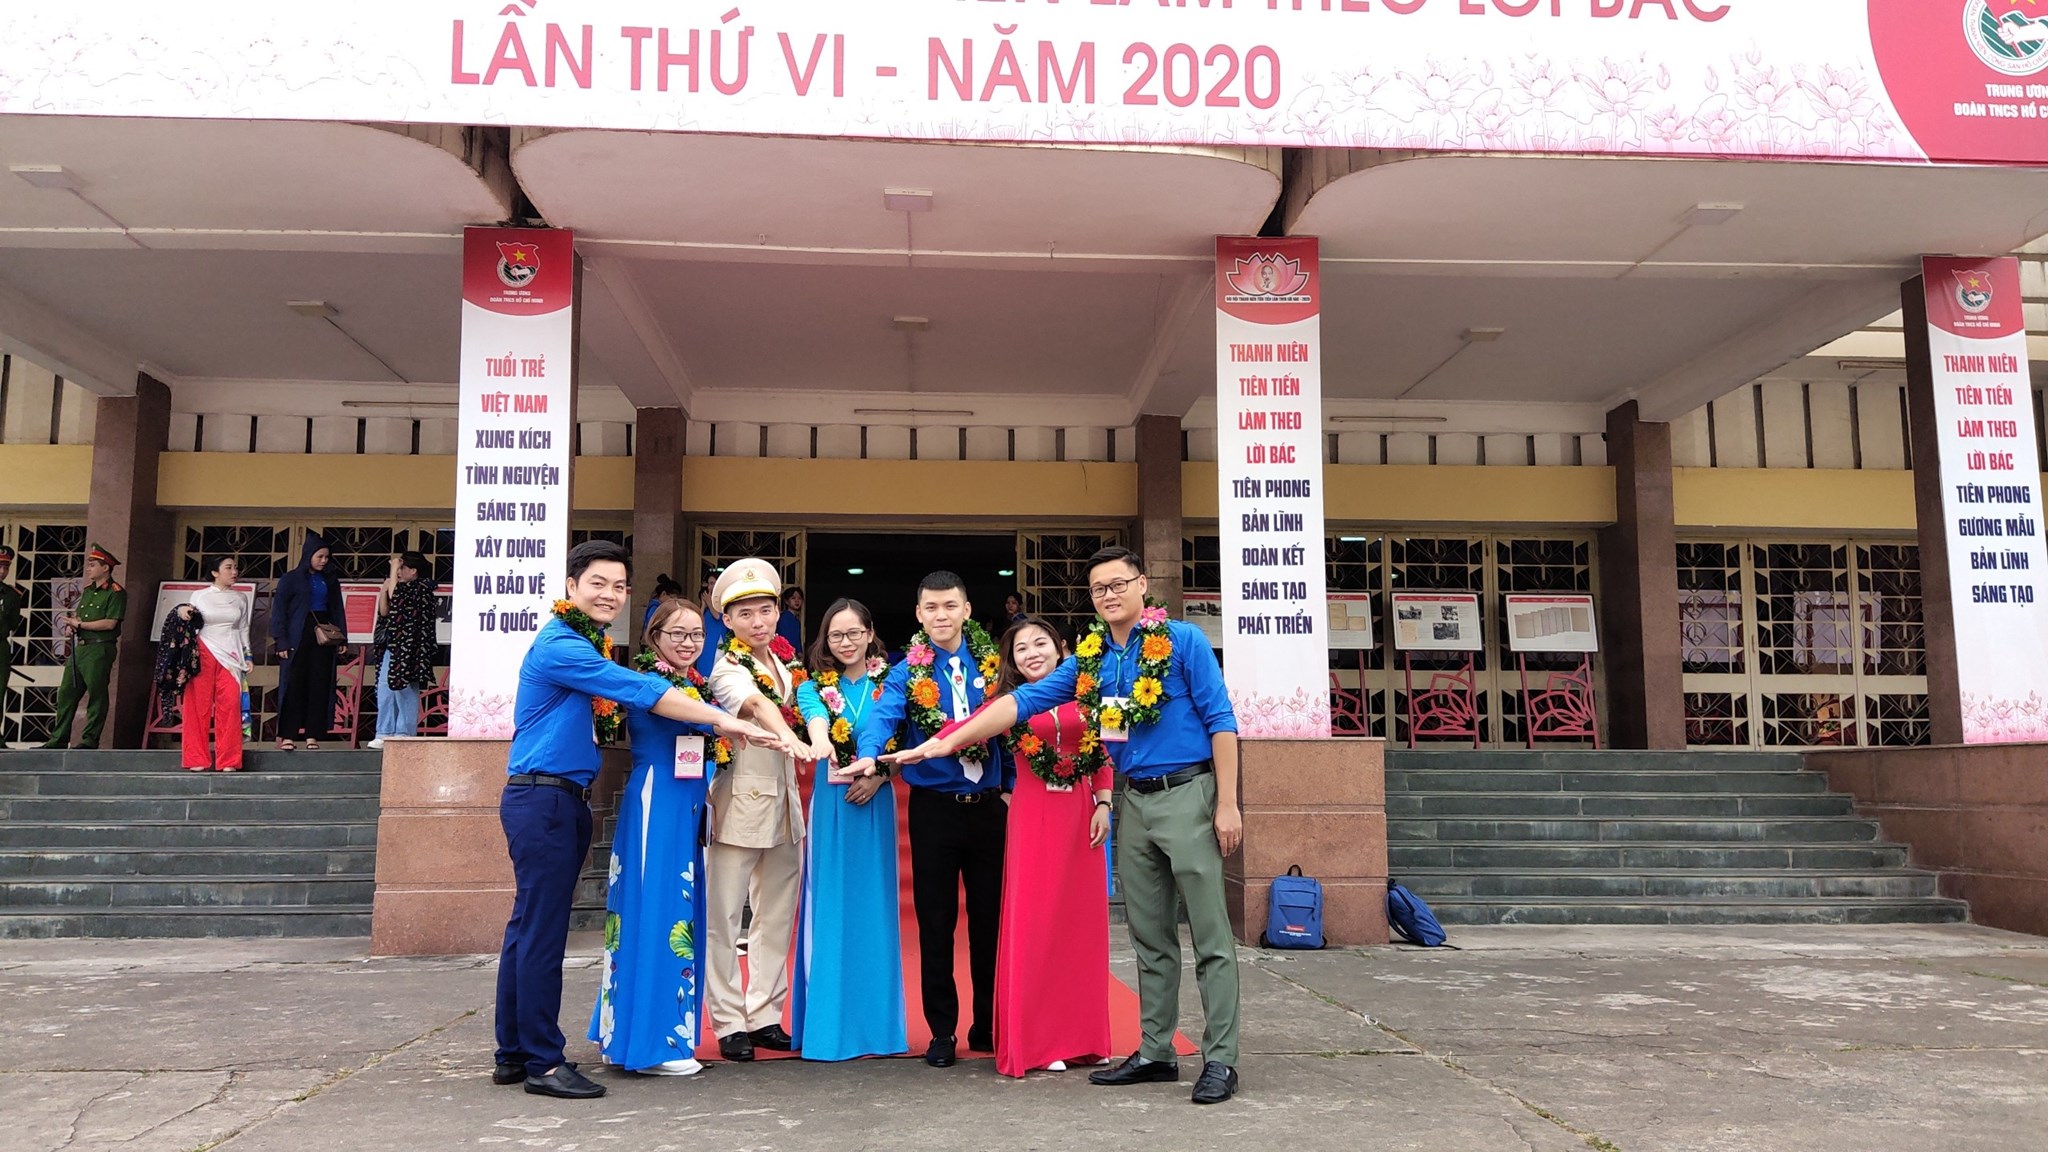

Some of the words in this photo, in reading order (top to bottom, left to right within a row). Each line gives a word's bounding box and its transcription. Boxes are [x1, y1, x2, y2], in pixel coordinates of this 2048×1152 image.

[451, 0, 593, 89] LẦN
[621, 7, 754, 95] THỨ
[777, 33, 844, 97] VI
[875, 66, 897, 77] -
[928, 23, 1095, 104] NĂM
[1122, 42, 1281, 109] 2020
[1985, 83, 2024, 98] TRUNG
[1954, 100, 1986, 116] ĐOÀN
[1988, 104, 2018, 118] TNCS
[1230, 344, 1272, 362] THANH
[1277, 340, 1308, 362] NIÊN
[1944, 355, 1985, 373] THANH
[1988, 352, 2018, 373] NIÊN
[486, 351, 516, 377] TUỔI
[520, 354, 545, 378] TRẺ
[1239, 374, 1268, 396] TIÊN
[1272, 372, 1300, 396] TIẾN
[1955, 384, 1983, 405] TIÊN
[1986, 382, 2013, 406] TIẾN
[481, 391, 510, 417] VIỆT
[514, 394, 548, 413] NAM
[1239, 408, 1266, 430] LÀM
[1270, 412, 1302, 430] THEO
[1958, 416, 1984, 438] LÀM
[1986, 420, 2018, 438] THEO
[475, 430, 514, 449] XUNG
[518, 427, 552, 449] KÍCH
[1246, 442, 1266, 464] LỜI
[1270, 442, 1296, 464] BÁC
[1967, 449, 1986, 470] LỜI
[1989, 450, 2014, 470] BÁC
[466, 462, 498, 485] TÌNH
[502, 463, 559, 490] NGUYỆN
[1232, 476, 1261, 498] TIÊN
[1266, 480, 1310, 498] PHONG
[1956, 482, 1984, 503] TIÊN
[1988, 486, 2031, 504] PHONG
[477, 499, 516, 521] SÁNG
[520, 503, 546, 526] TẠO
[1242, 508, 1270, 532] BẢN
[1274, 510, 1303, 532] LĨNH
[1958, 516, 2002, 536] GƯƠNG
[2006, 512, 2035, 536] MẪU
[475, 535, 502, 558] XÂY
[506, 537, 546, 562] DỰNG
[1242, 544, 1278, 566] ĐOÀN
[1282, 542, 1305, 566] KẾT
[1970, 546, 1998, 570] BẢN
[2000, 548, 2030, 570] LĨNH
[474, 572, 492, 594] VÀ
[496, 569, 524, 594] BẢO
[528, 572, 546, 600] VỆ
[1242, 578, 1278, 600] SÁNG
[1282, 582, 1307, 604] TẠO
[1972, 582, 2008, 603] SÁNG
[2010, 585, 2034, 608] TẠO
[479, 604, 496, 632] TỔ
[500, 606, 538, 634] QUỐC
[1238, 612, 1271, 634] PHÁT
[1274, 608, 1312, 634] TRIỂN
